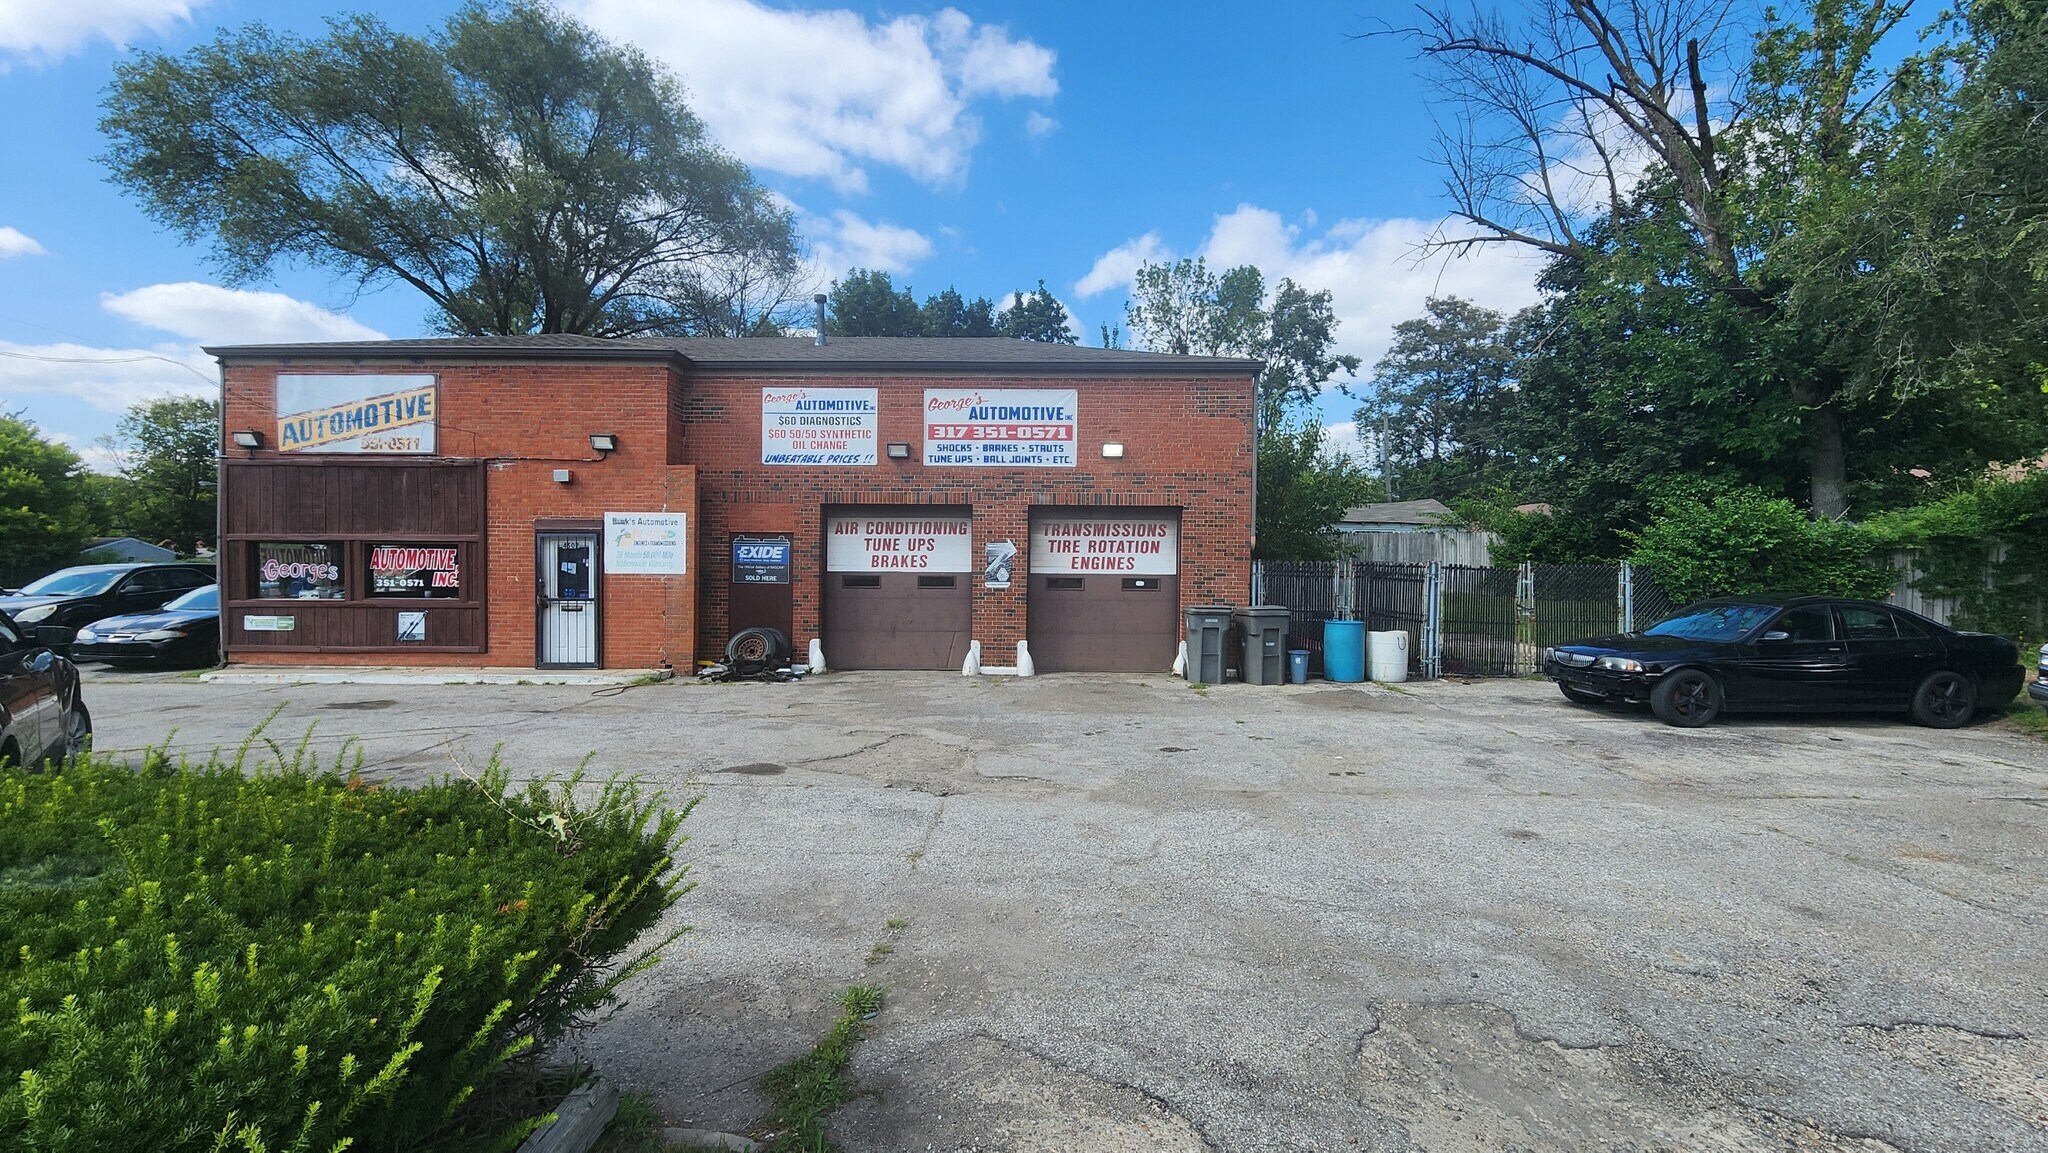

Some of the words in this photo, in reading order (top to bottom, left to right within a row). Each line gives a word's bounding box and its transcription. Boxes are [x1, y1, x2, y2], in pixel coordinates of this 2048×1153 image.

[764, 390, 809, 404] George's
[929, 392, 989, 412] George's
[796, 400, 869, 411] AUTOMOTIVE
[282, 393, 432, 446] AUTOMOTIVE
[969, 407, 1064, 421] AUTOMOTIVE
[779, 416, 796, 426] $60
[800, 416, 862, 426] DIAGNOSTICS
[769, 429, 786, 439] $60
[790, 430, 817, 439] 50/50
[820, 430, 872, 439] SYNTHETIC
[934, 427, 968, 438] 317
[973, 427, 1068, 439] 351-0571
[793, 441, 807, 450] OIL
[810, 441, 848, 450] CHANGE
[937, 444, 972, 452] SHOCKS
[983, 444, 1018, 452] BRAKES
[1029, 445, 1064, 453] STRUTS
[765, 454, 825, 463] UNBEATABLE
[826, 454, 861, 463] PRICES
[928, 455, 952, 463] TUNE
[955, 455, 973, 463] UPS
[1009, 456, 1042, 464] JOINTS
[1053, 456, 1072, 464] ETC.
[638, 518, 678, 526] Automotive
[835, 521, 859, 535] AIR
[866, 521, 968, 535] CONDITIONING
[1043, 523, 1168, 537] TRANSMISSIONS
[864, 538, 904, 552] TUNE
[908, 538, 935, 552] UPS
[1048, 540, 1080, 553] TIRE
[1088, 540, 1160, 554] ROTATION
[738, 546, 784, 559] EXIDE
[871, 555, 928, 568] BRAKES
[1071, 557, 1135, 570] ENGINES
[263, 559, 338, 583] George's
[376, 579, 424, 587] 351-0571
